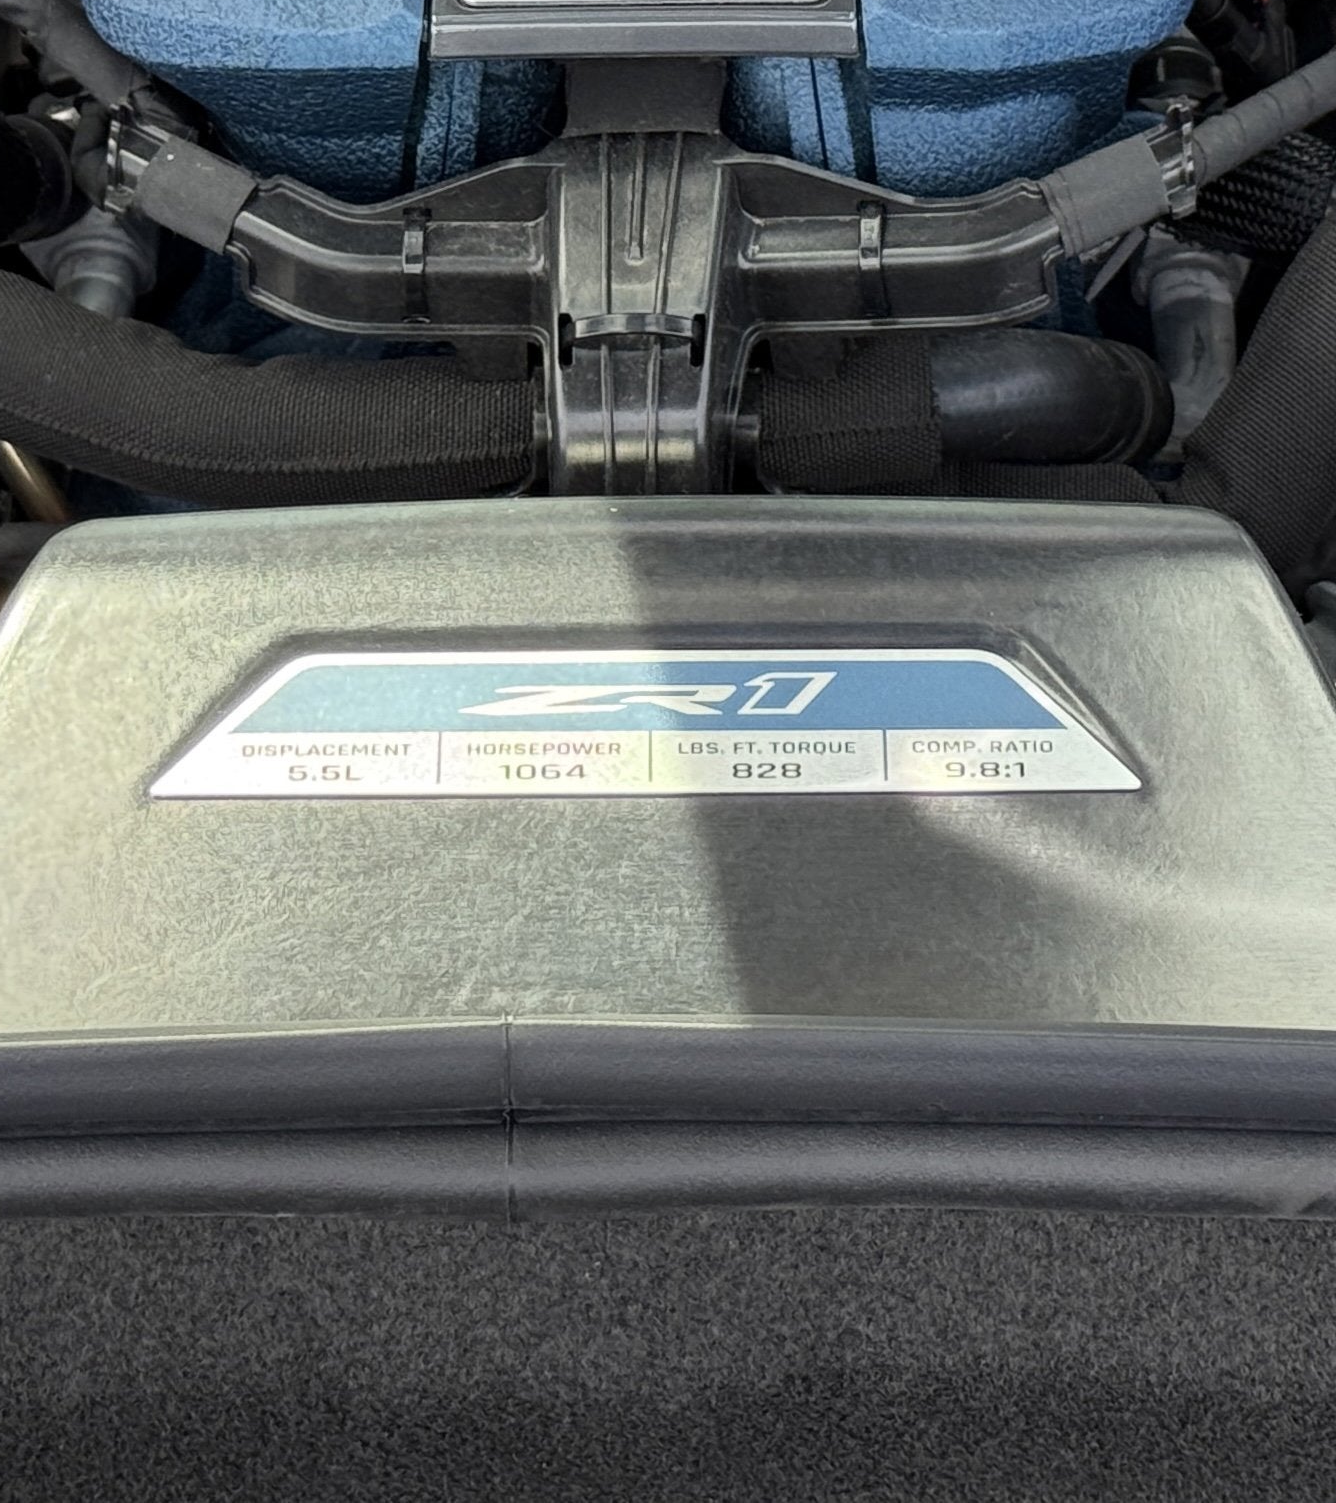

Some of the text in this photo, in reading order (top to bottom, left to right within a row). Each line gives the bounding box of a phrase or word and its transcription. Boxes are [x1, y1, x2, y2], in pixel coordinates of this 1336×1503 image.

[457, 671, 838, 715] ZR1
[241, 743, 412, 758] DISPLACEMENT
[466, 742, 623, 757] HORSEPOWER
[677, 740, 856, 755] LBS. FT. TORQUE
[911, 739, 1054, 754] COMP. RATIO
[287, 764, 363, 782] 5.5L
[498, 763, 588, 781] 1064
[732, 762, 803, 779] 828
[945, 761, 1026, 778] 9.8:1
